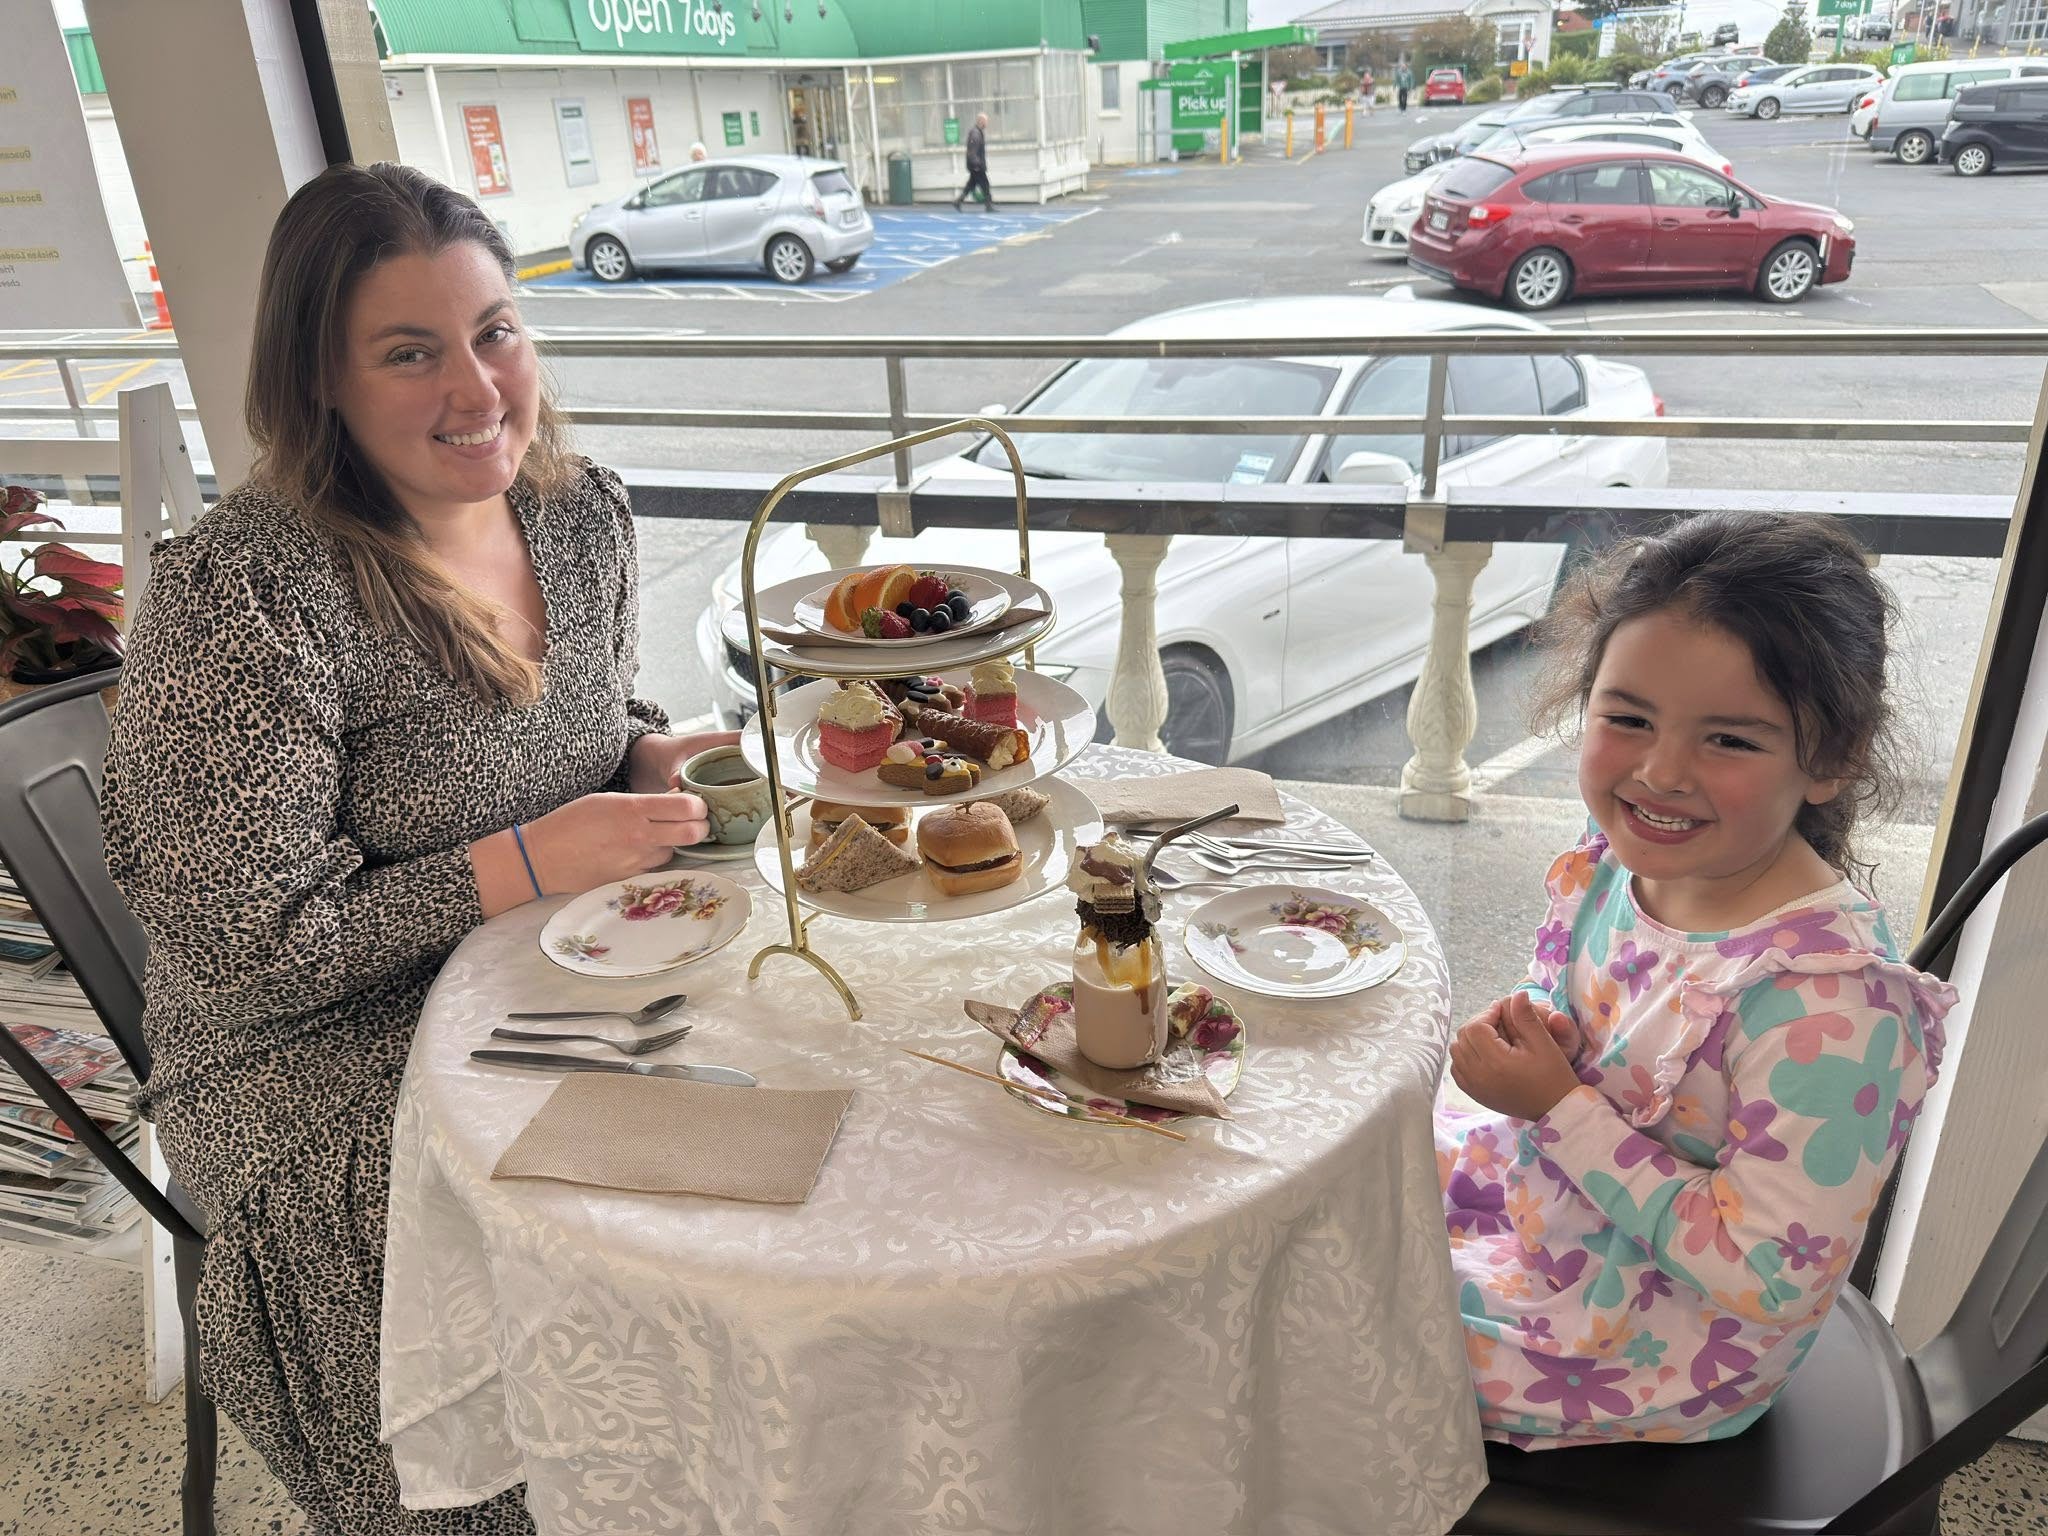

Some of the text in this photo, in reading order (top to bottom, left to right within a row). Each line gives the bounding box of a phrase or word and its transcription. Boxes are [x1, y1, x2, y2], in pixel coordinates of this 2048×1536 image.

[588, 0, 673, 48] open
[1179, 96, 1227, 112] Pick up
